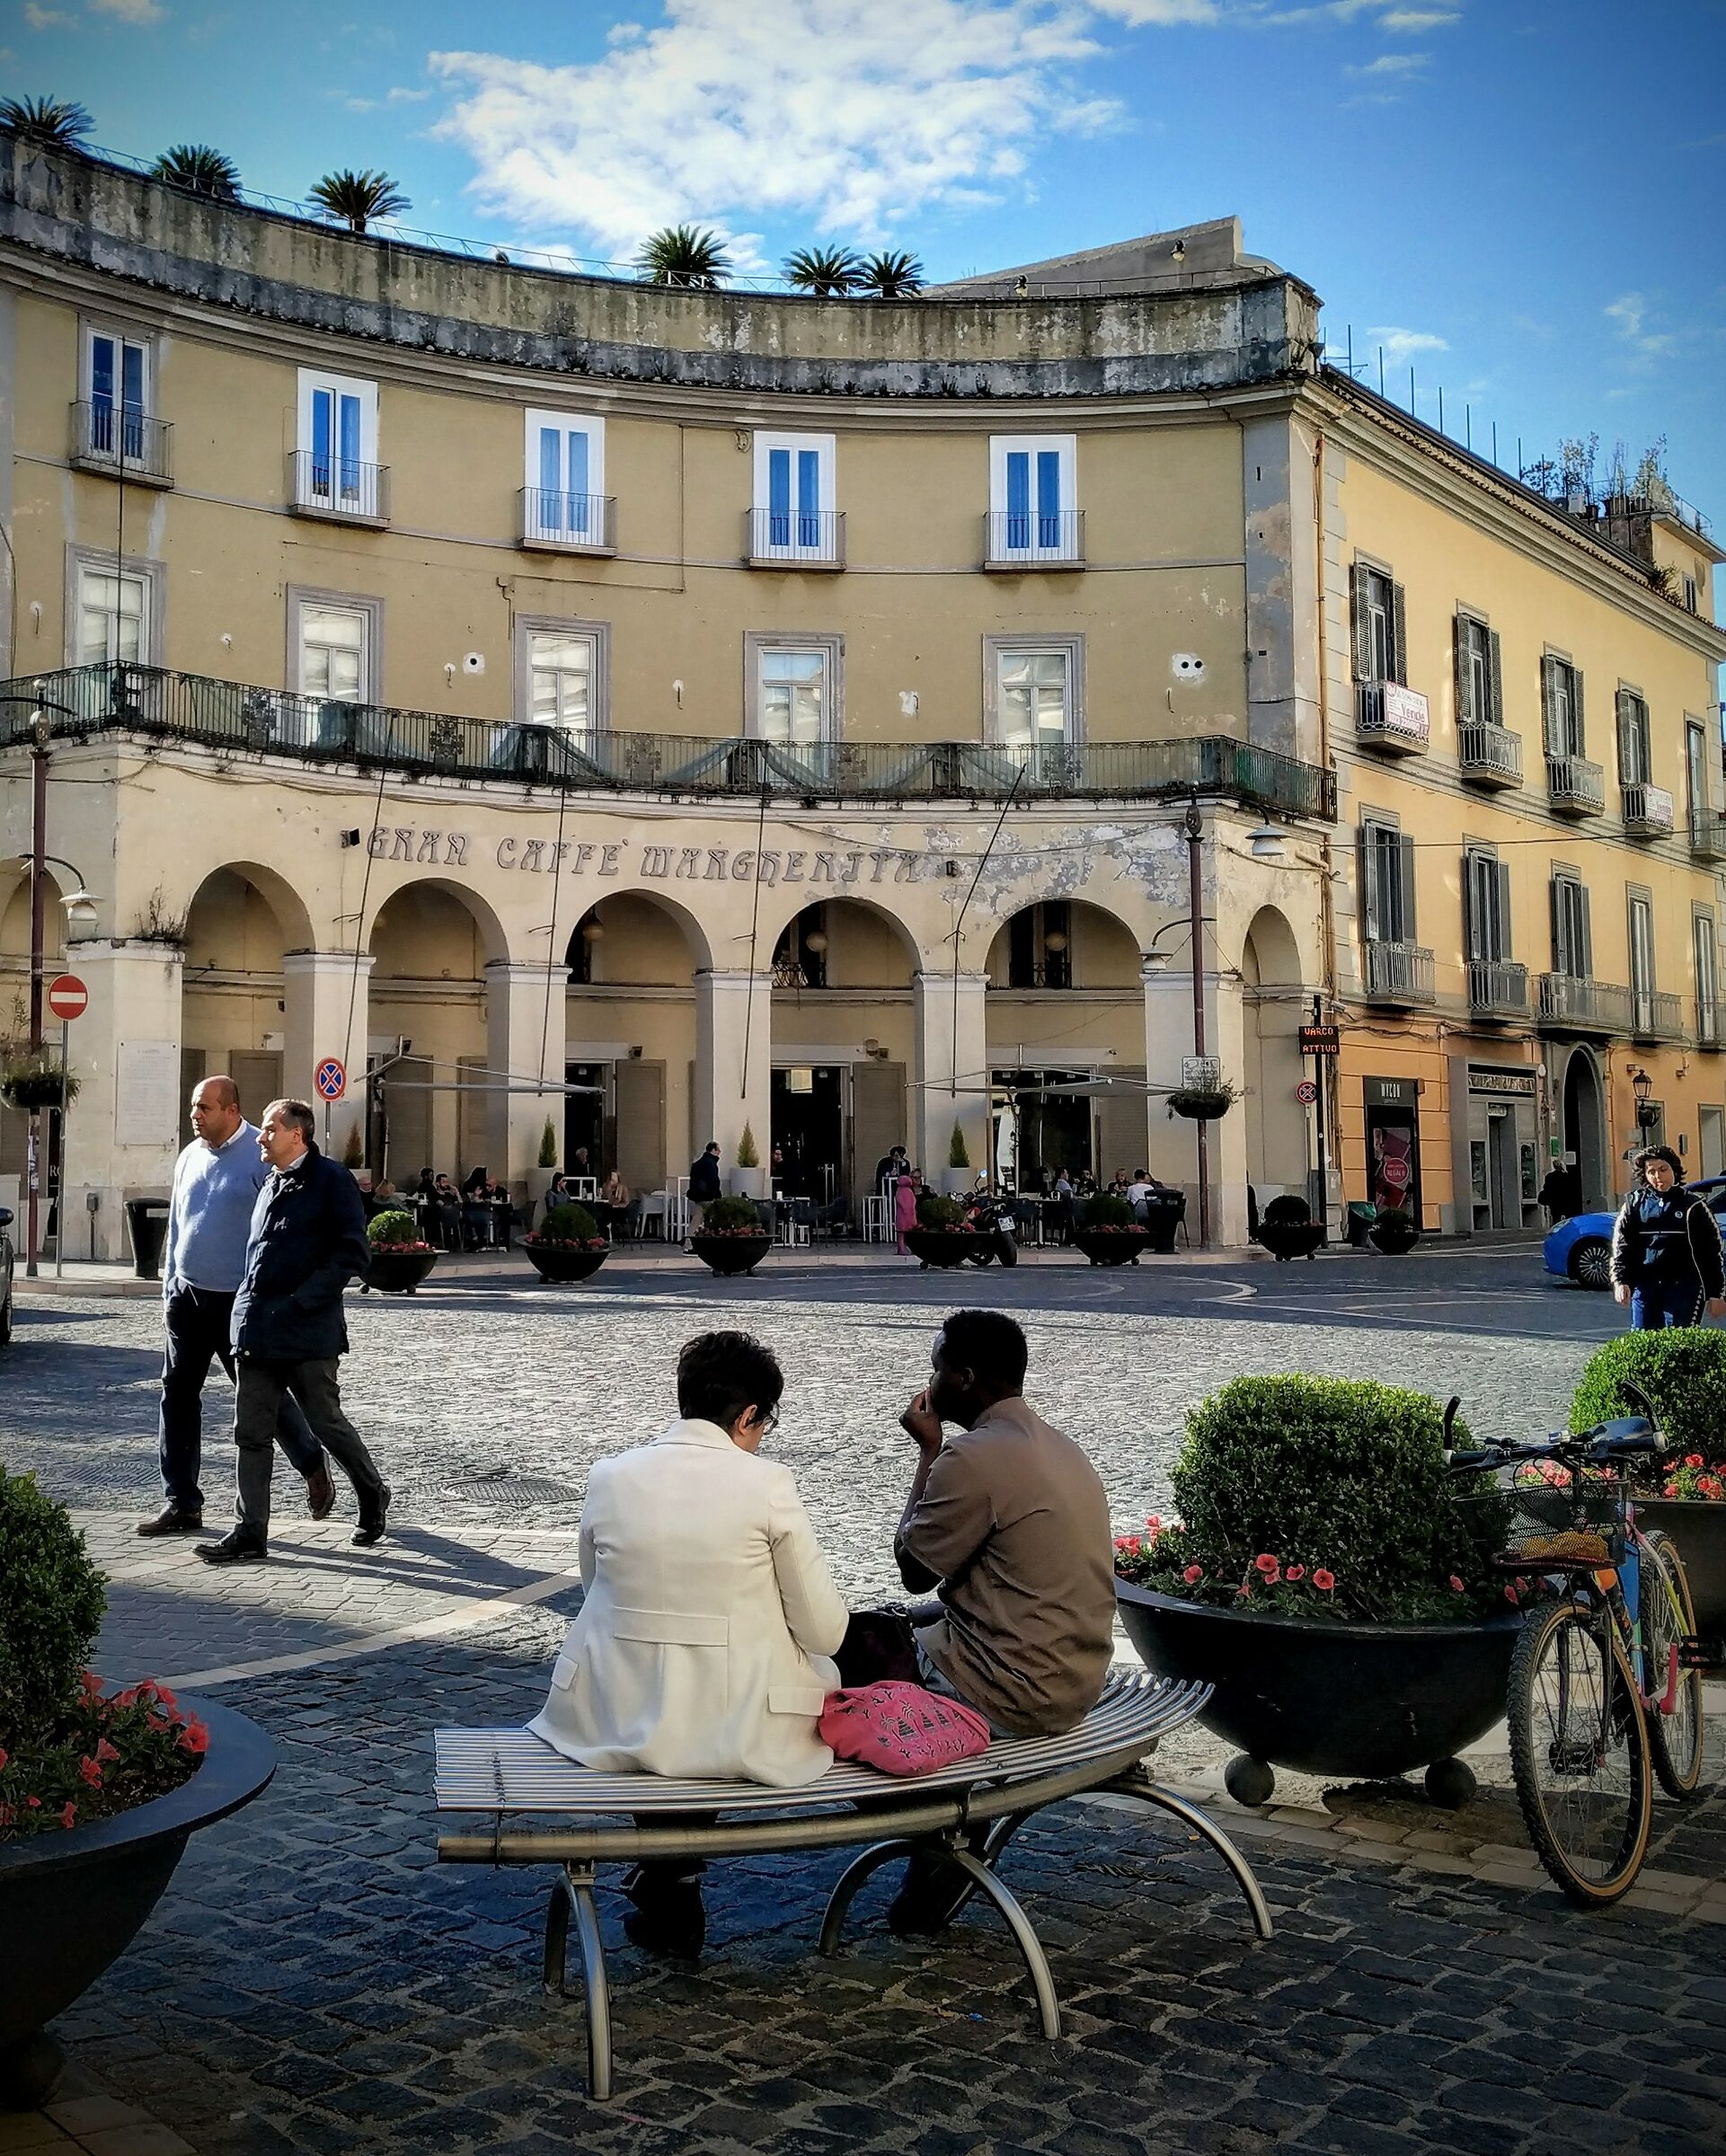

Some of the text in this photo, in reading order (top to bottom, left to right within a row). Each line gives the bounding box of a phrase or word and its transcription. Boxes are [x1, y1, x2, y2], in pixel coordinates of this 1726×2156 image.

[367, 827, 468, 866] GRAN
[640, 845, 921, 888] MARGHERITA
[1304, 1027, 1334, 1036] VARCO
[1302, 1044, 1338, 1053] ATTIVO
